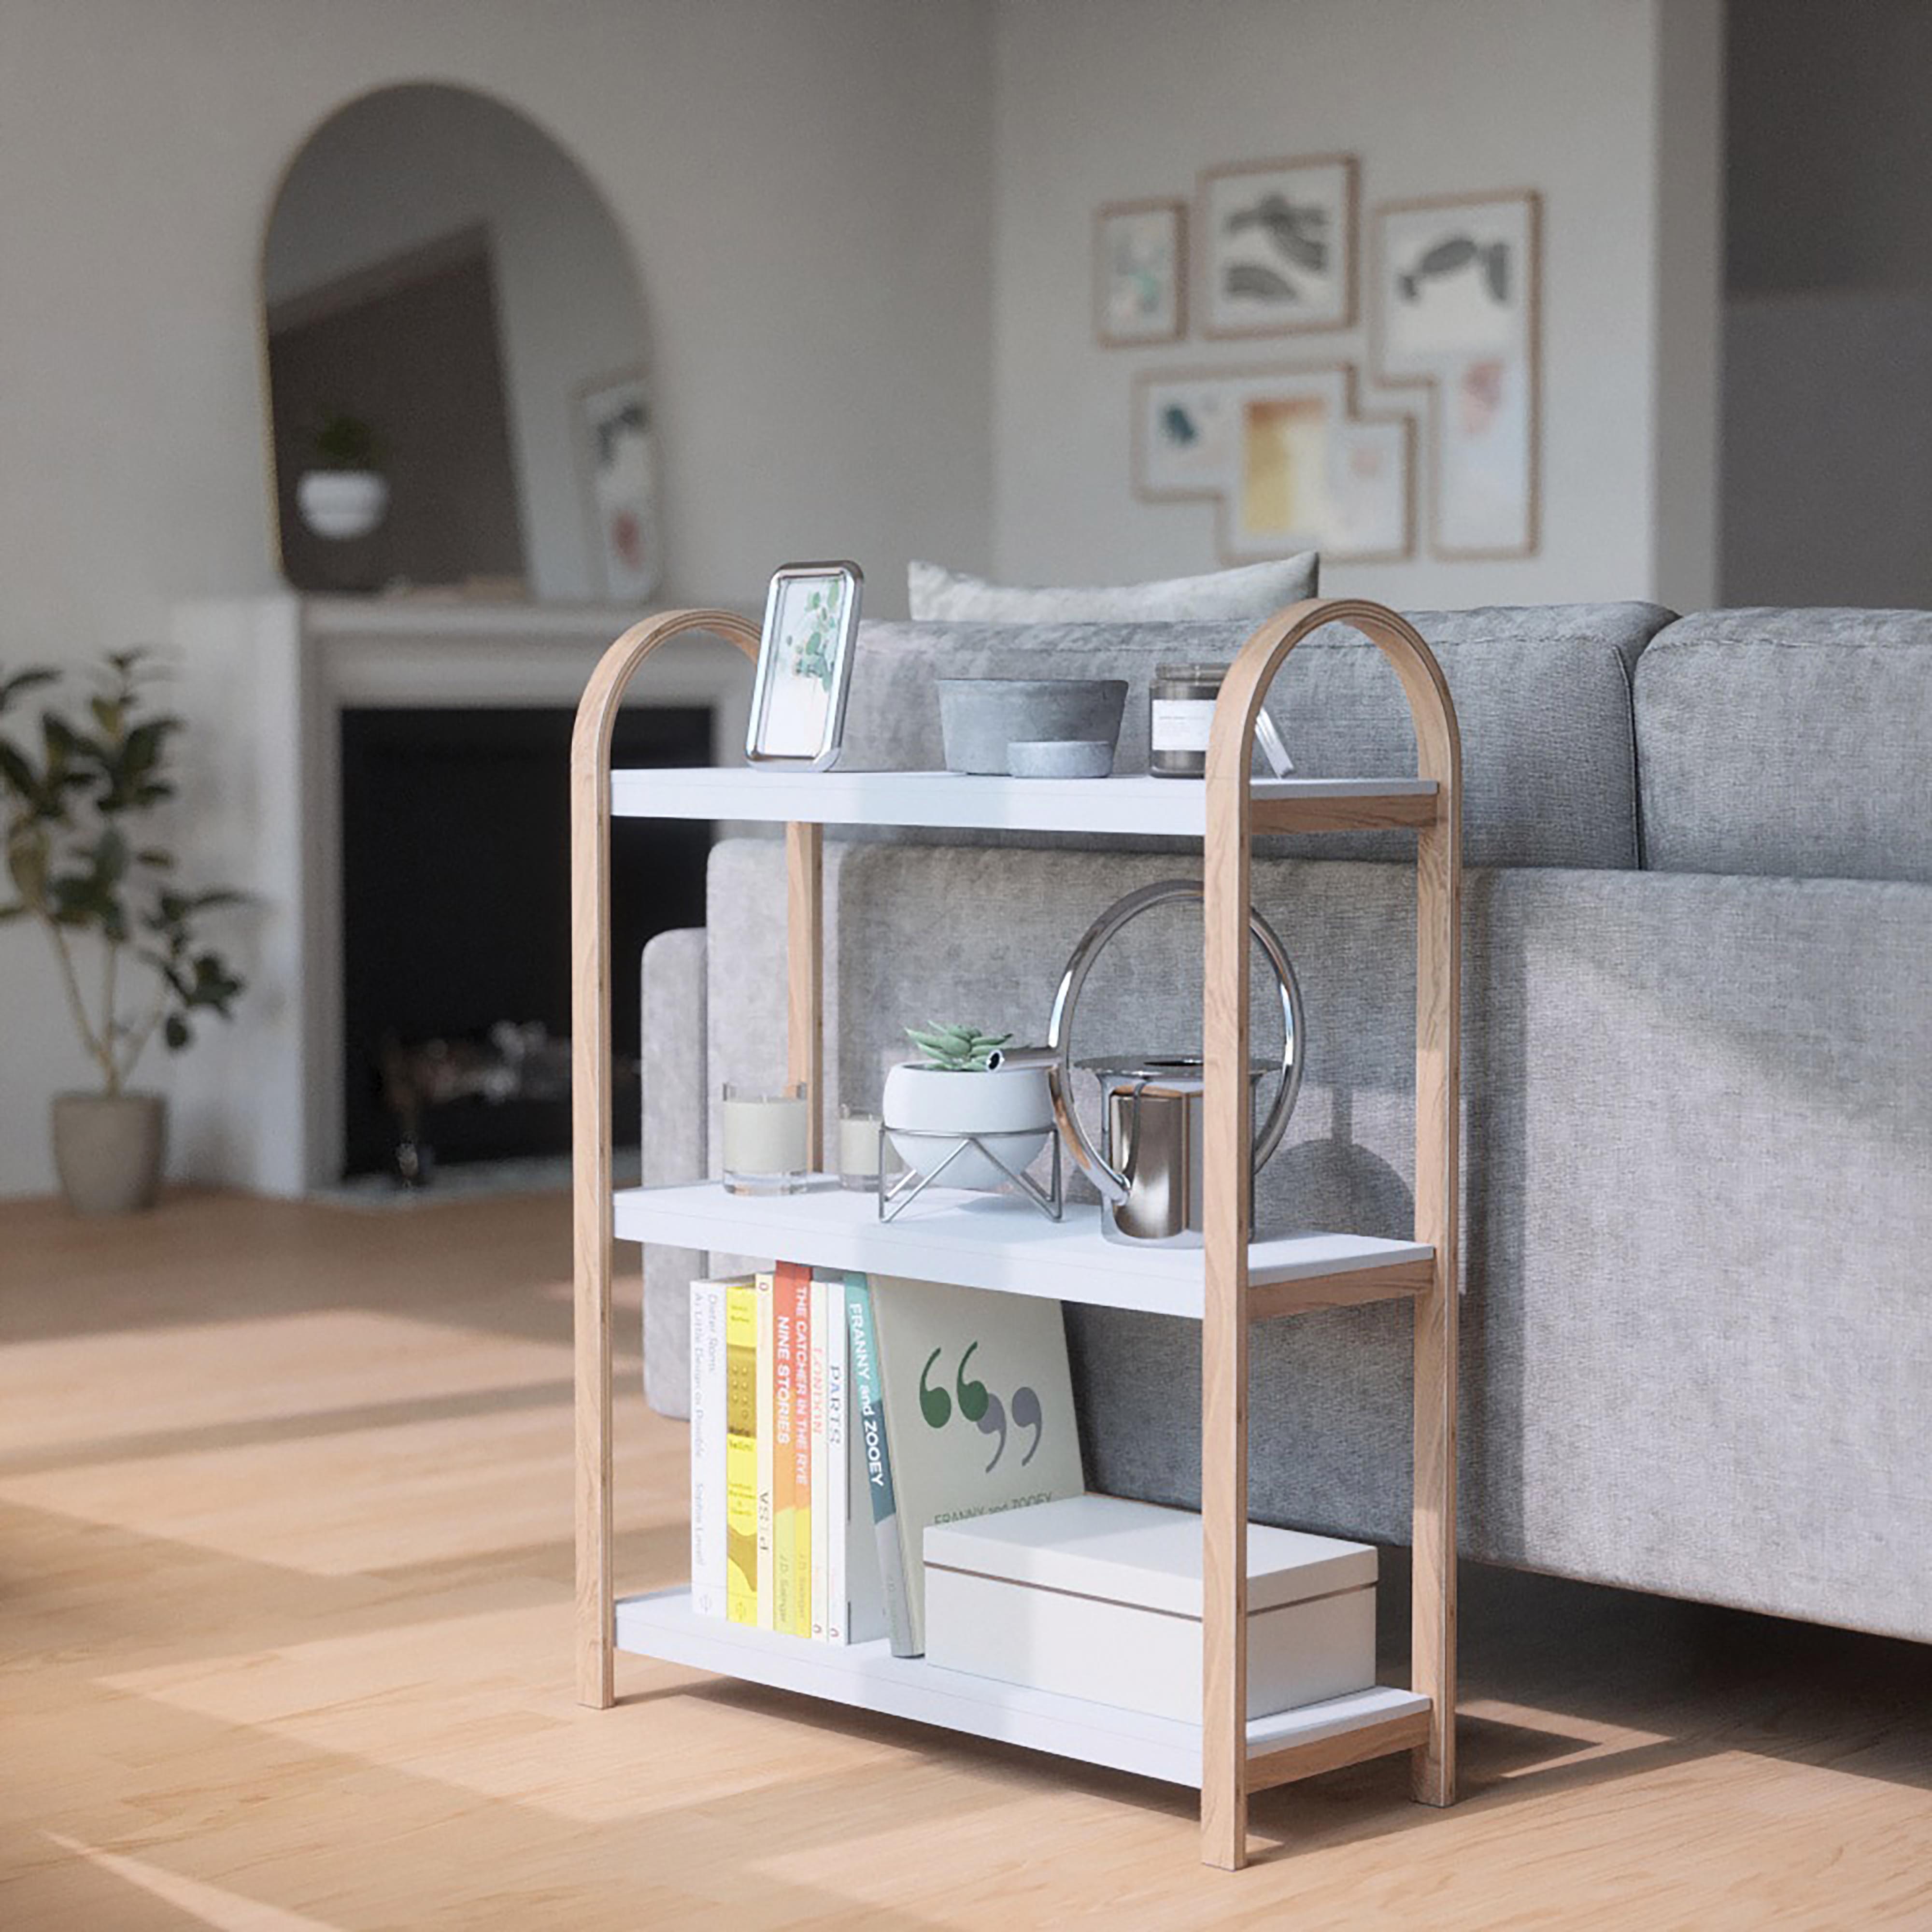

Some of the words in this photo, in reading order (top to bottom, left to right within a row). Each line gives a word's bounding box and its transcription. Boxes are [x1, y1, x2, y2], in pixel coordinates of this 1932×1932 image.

[796, 1286, 808, 1315] THE
[777, 1316, 790, 1361] NINE
[796, 1321, 808, 1394] CATCHER
[850, 1303, 870, 1380] FRANNY
[777, 1364, 791, 1444] STORIES
[796, 1399, 808, 1415] IN
[813, 1348, 823, 1434] LONDON
[859, 1384, 875, 1416] and
[796, 1421, 808, 1449] THE
[864, 1421, 884, 1486] ZOOEY
[796, 1453, 809, 1484] RYE
[934, 1506, 985, 1524] FRANNY
[1011, 1491, 1052, 1509] ZOOEY
